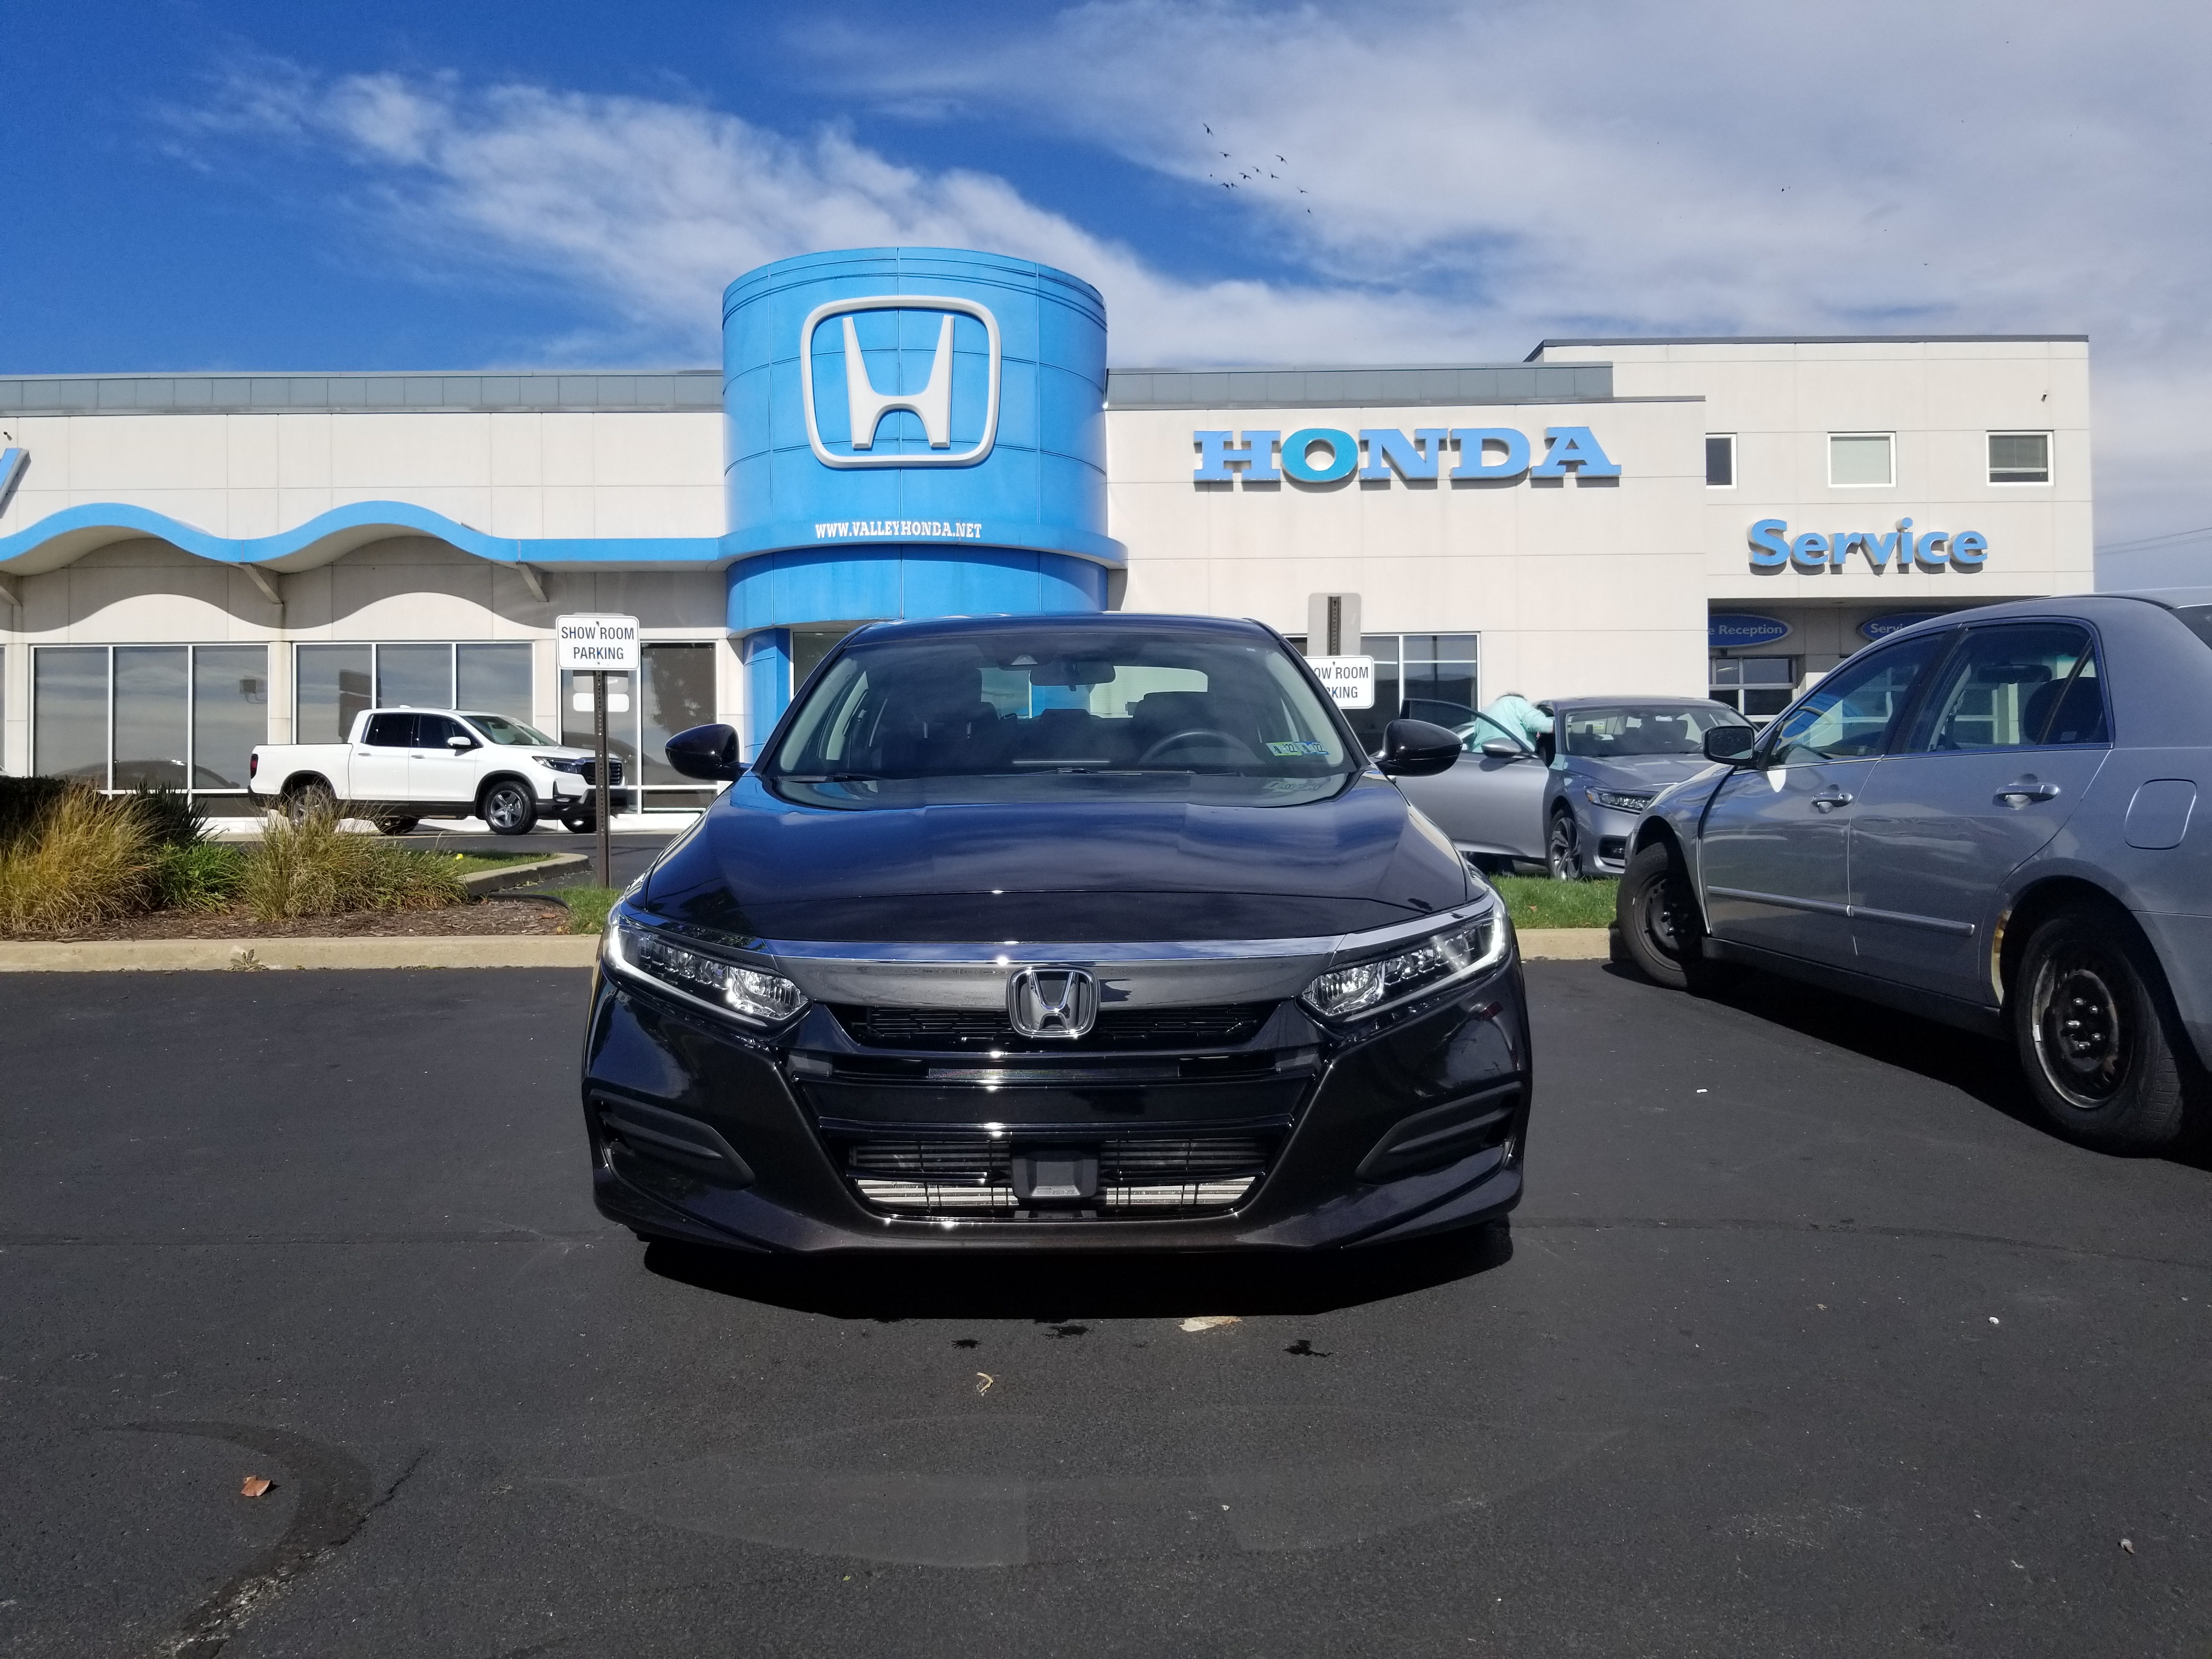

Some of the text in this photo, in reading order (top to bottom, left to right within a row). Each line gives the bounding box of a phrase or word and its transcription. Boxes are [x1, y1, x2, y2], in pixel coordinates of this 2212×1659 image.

[1193, 426, 1622, 483] HONDA
[815, 521, 982, 538] WWW.VALLEYHONDA.NET
[1749, 517, 1988, 566] Service
[561, 627, 634, 640] SHOW ROOM
[1719, 624, 1782, 637] Reception
[573, 647, 624, 659] PARKING
[1335, 667, 1368, 679] ROOM
[1327, 686, 1358, 698] KING
